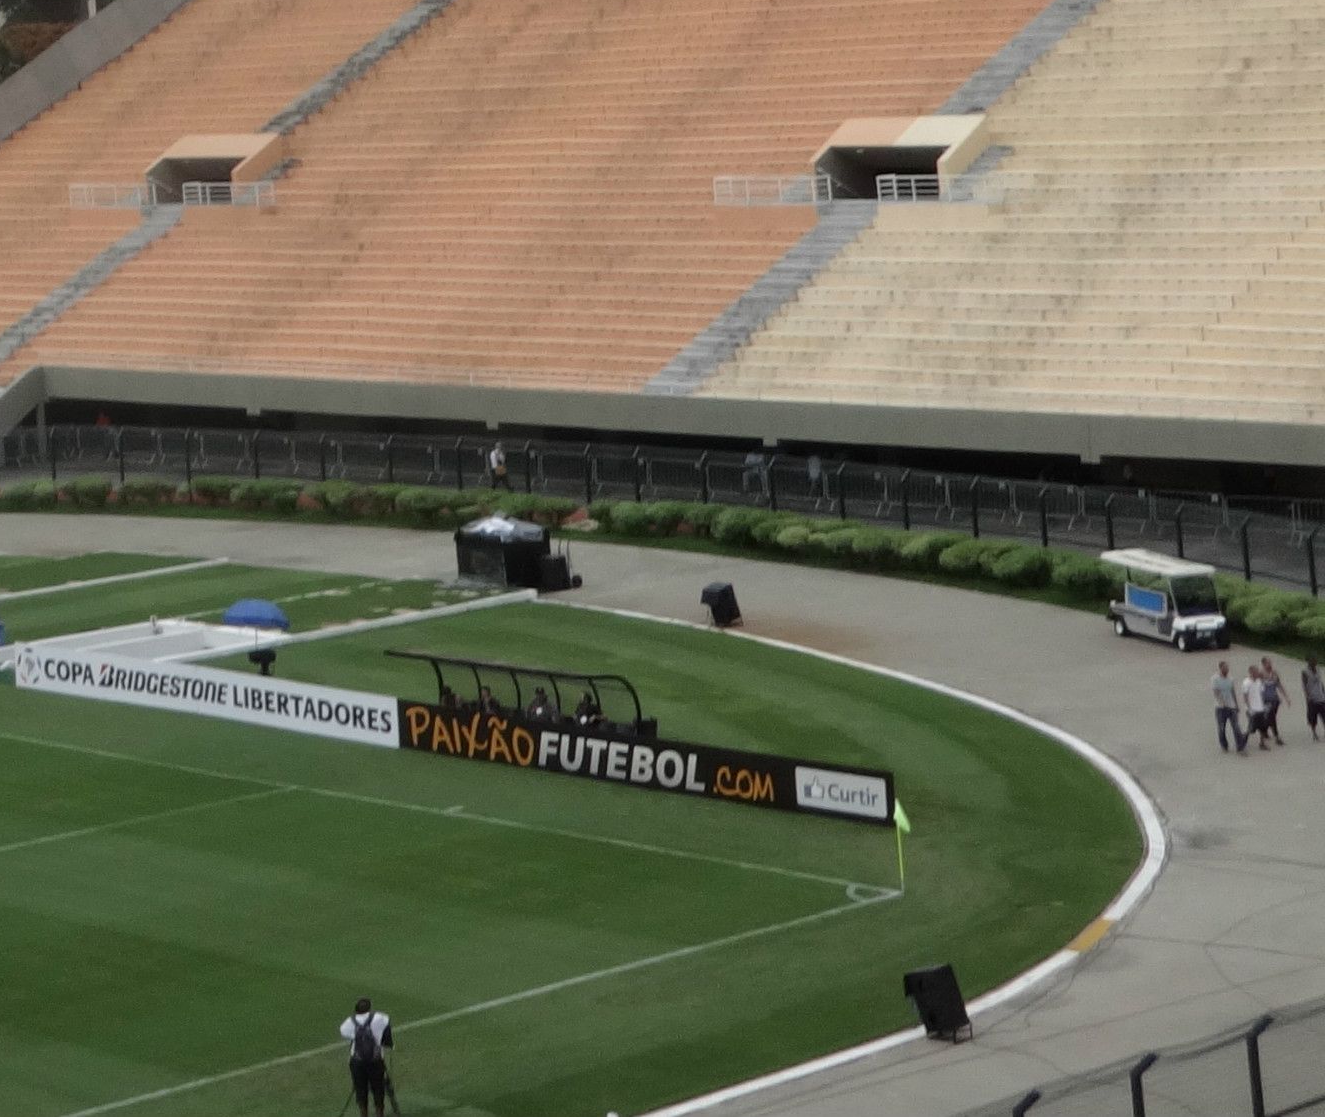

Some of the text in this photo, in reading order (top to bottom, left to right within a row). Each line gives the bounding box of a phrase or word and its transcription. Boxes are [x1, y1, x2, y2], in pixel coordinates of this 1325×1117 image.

[44, 658, 393, 734] COPA BRIDGESTONE LIBERTADORES
[404, 705, 534, 767] PAIXÃO
[537, 731, 707, 793] FUTEBOL
[827, 786, 879, 808] Curtir
